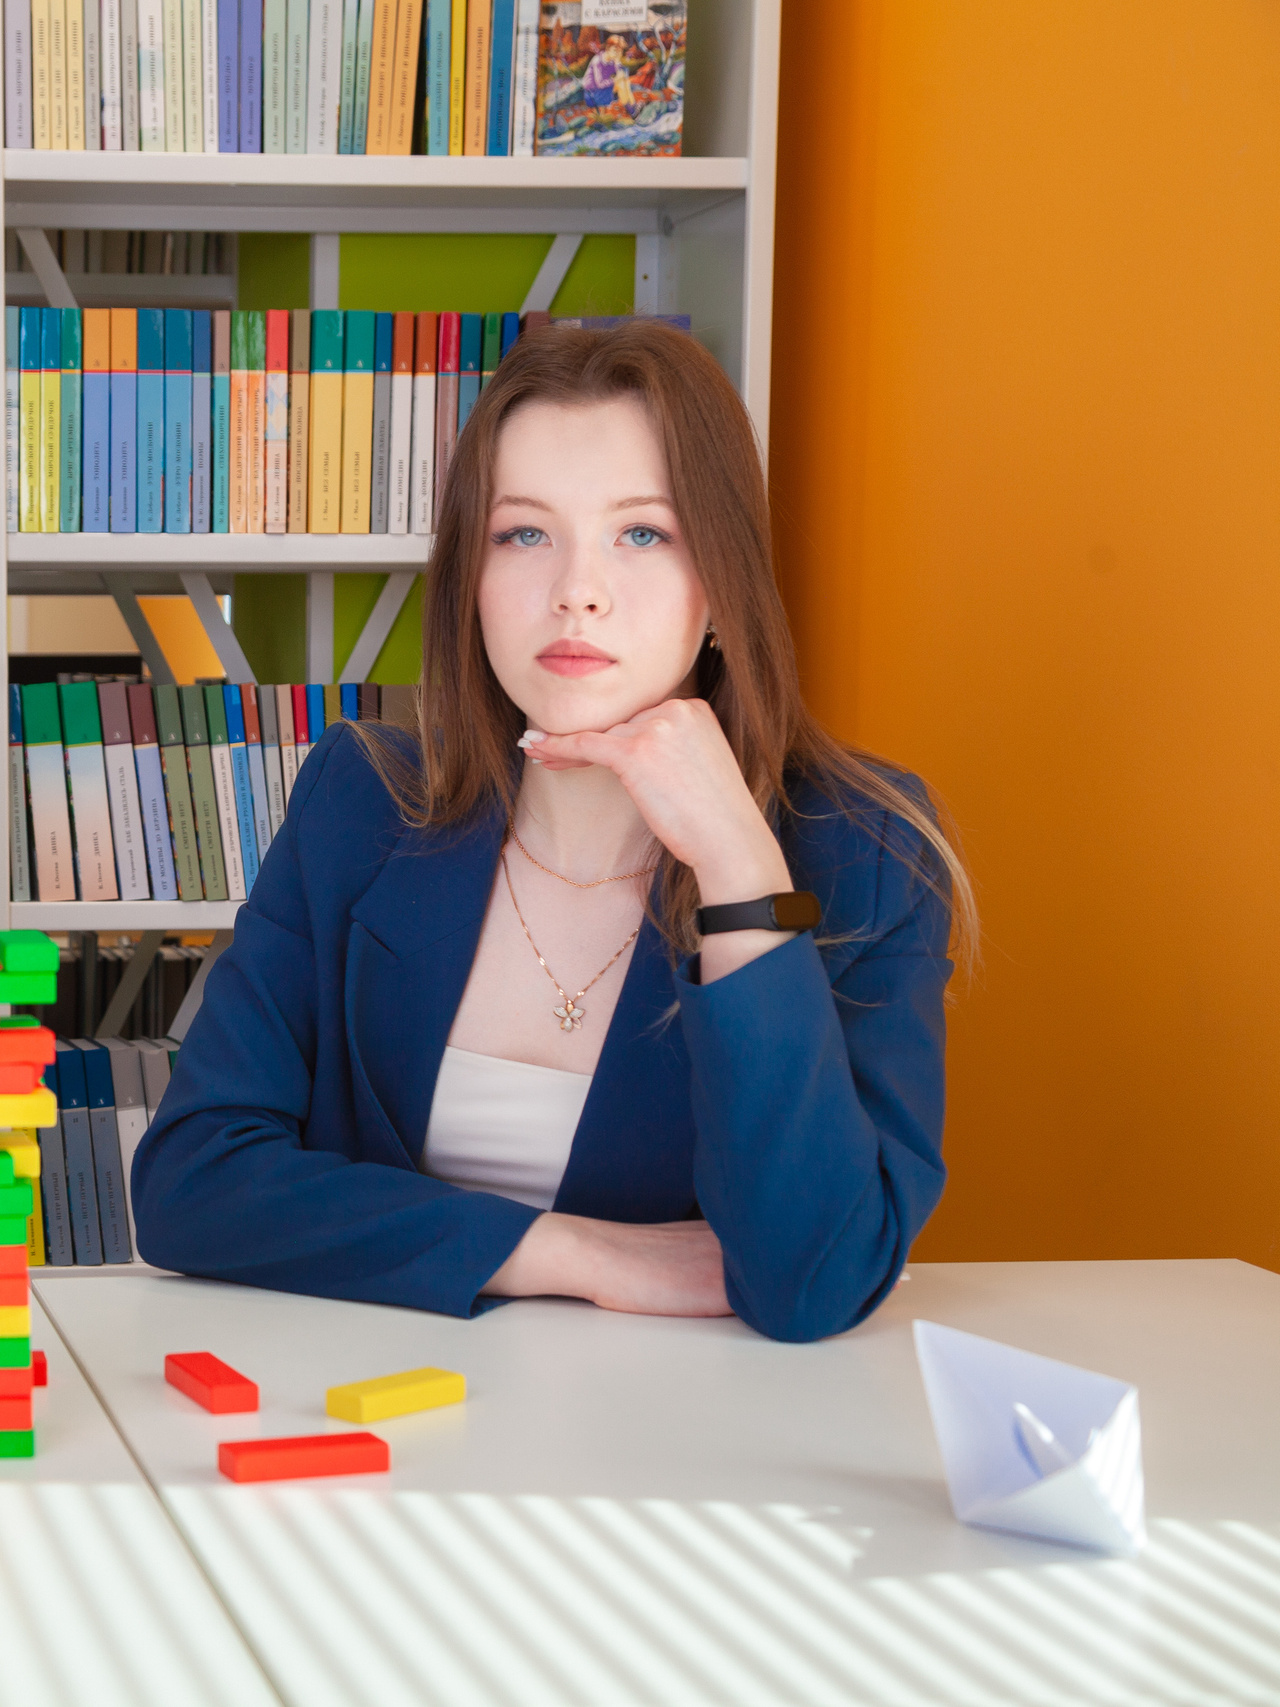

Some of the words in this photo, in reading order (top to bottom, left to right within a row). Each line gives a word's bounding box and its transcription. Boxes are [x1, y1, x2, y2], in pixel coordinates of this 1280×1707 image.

[152, 798, 160, 831] БЕРЛИНА
[156, 834, 161, 842] ДО
[181, 820, 189, 849] СМЕРТИ
[206, 820, 214, 849] СМЕРТИ
[158, 847, 166, 877] МОСКВЫ
[162, 881, 168, 890] ОТ
[78, 1172, 86, 1200] ПЕРВЫЙ
[106, 1171, 114, 1199] ПЕРВЫЙ
